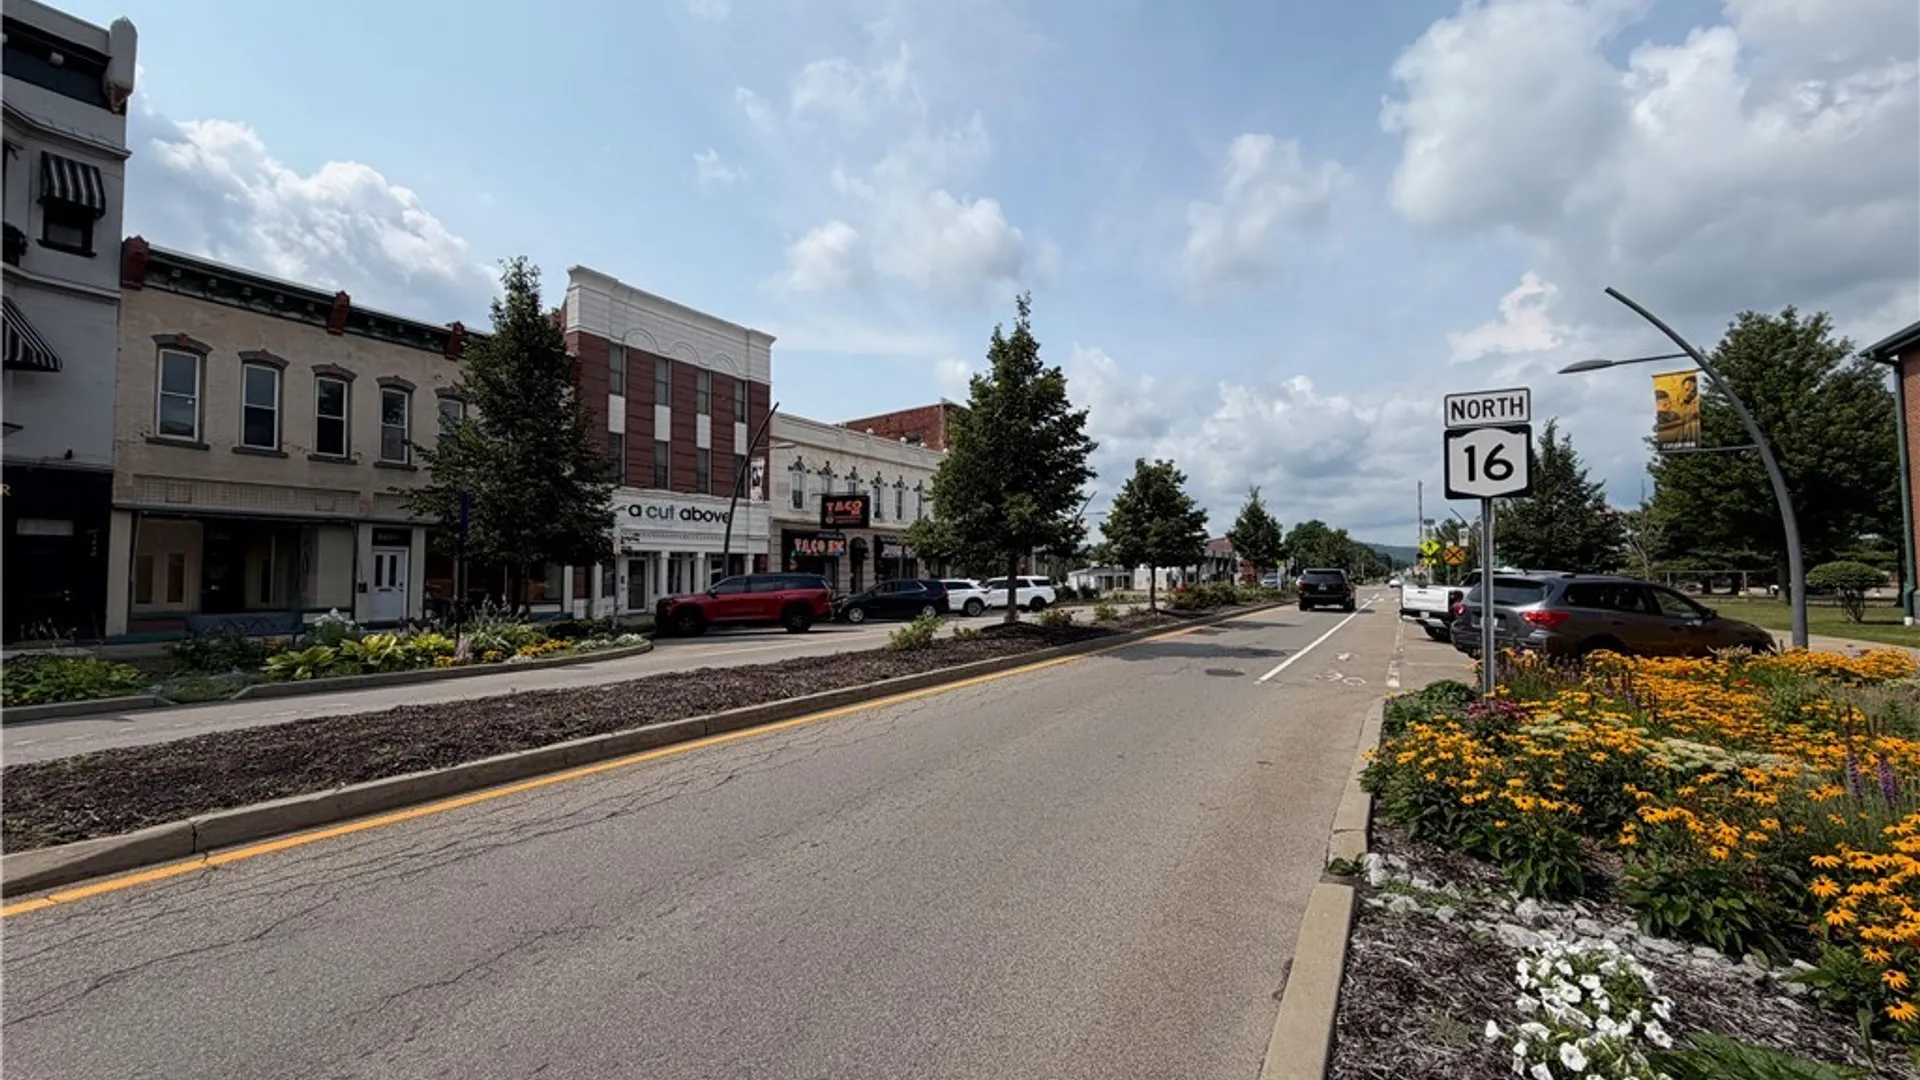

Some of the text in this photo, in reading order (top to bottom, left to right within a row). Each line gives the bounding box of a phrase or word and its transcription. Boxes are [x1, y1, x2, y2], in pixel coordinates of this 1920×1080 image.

[1451, 396, 1523, 421] NORTH
[1464, 443, 1514, 482] 16
[628, 504, 731, 524] a cut above
[826, 501, 862, 512] TACO
[794, 538, 826, 553] TACO
